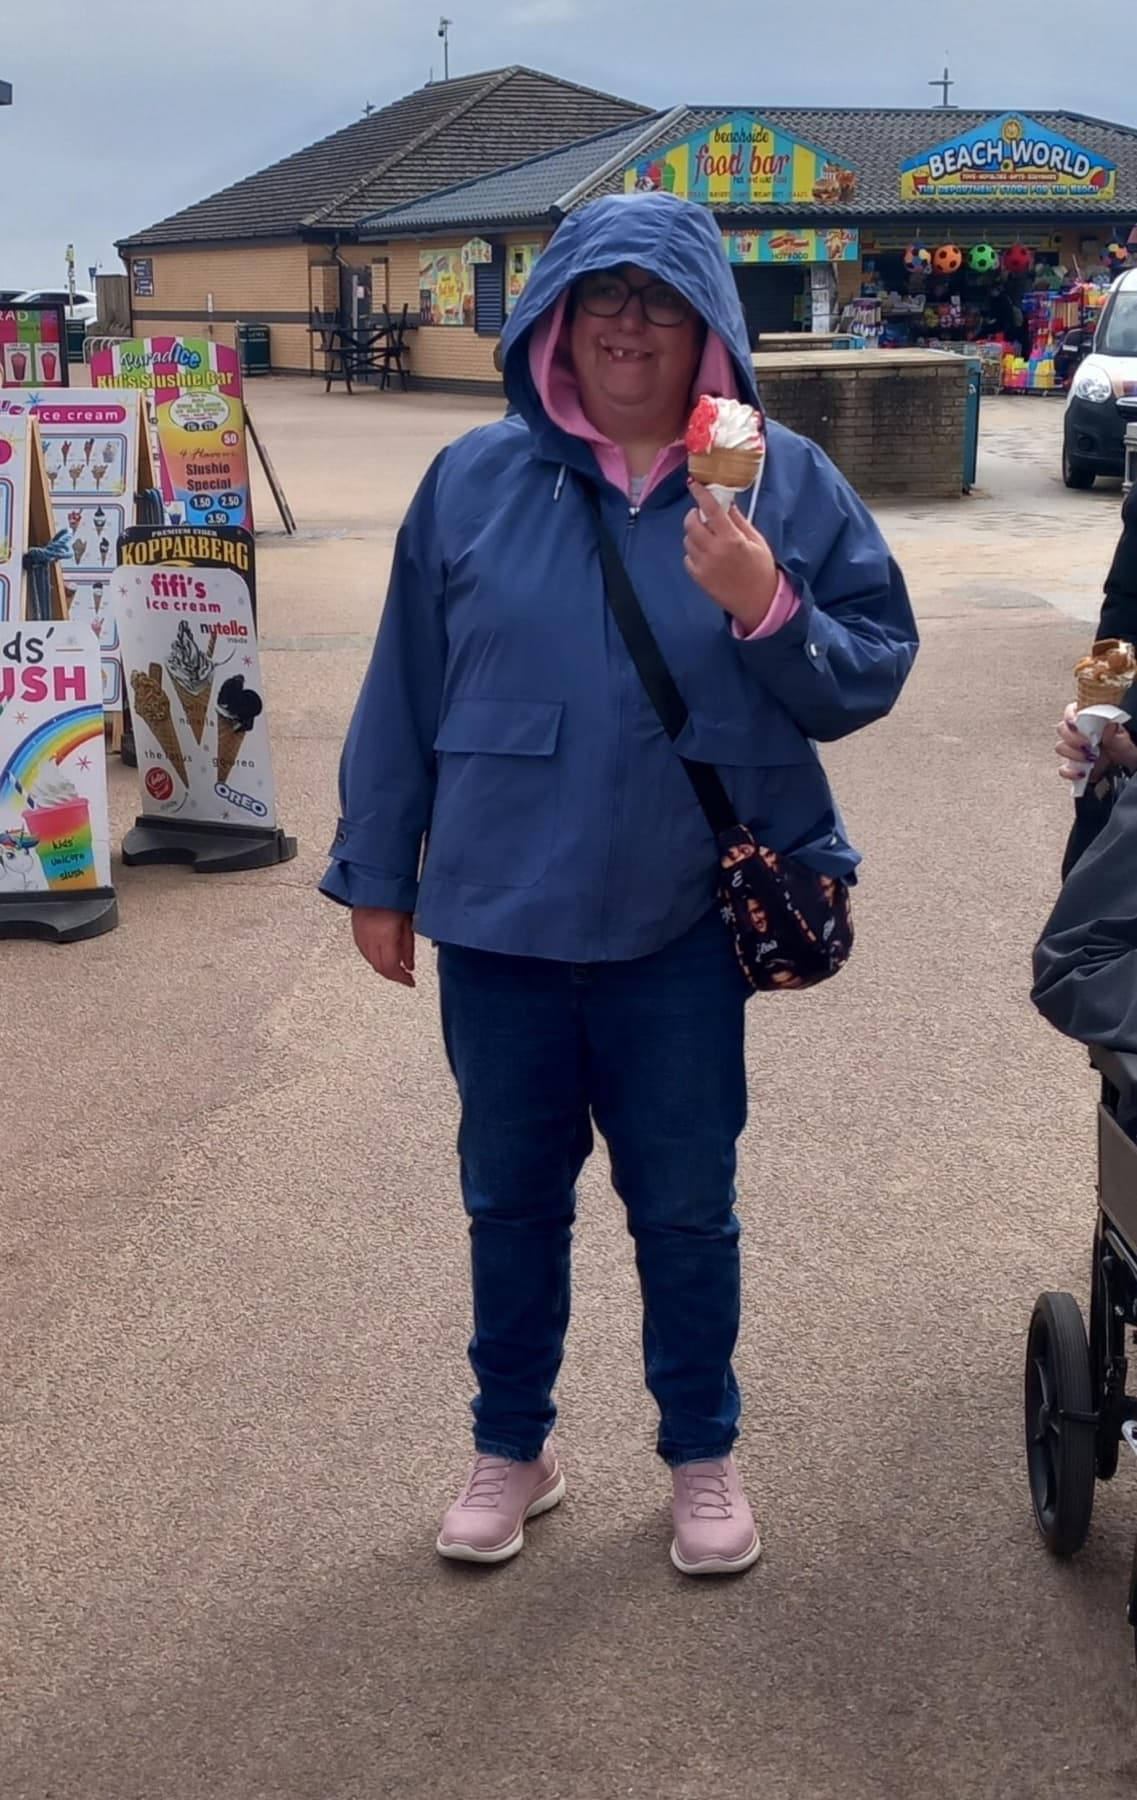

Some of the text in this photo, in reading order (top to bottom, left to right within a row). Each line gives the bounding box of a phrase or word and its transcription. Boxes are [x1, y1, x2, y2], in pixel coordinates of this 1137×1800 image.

[714, 125, 769, 143] beachside
[694, 143, 790, 185] food bar
[928, 139, 1090, 180] BEACH WORLD
[918, 184, 935, 195] THE
[938, 184, 997, 195] DEPARTMENT
[999, 184, 1028, 195] STORE
[206, 373, 233, 386] Bar
[67, 412, 118, 421] cream
[186, 463, 230, 475] Slushie
[187, 479, 231, 491] Special
[151, 529, 191, 537] PREMIUM
[121, 536, 249, 571] KOPPARBERG
[151, 573, 206, 598] fifi's
[145, 596, 221, 613] ice cream
[214, 782, 267, 817] OREO
